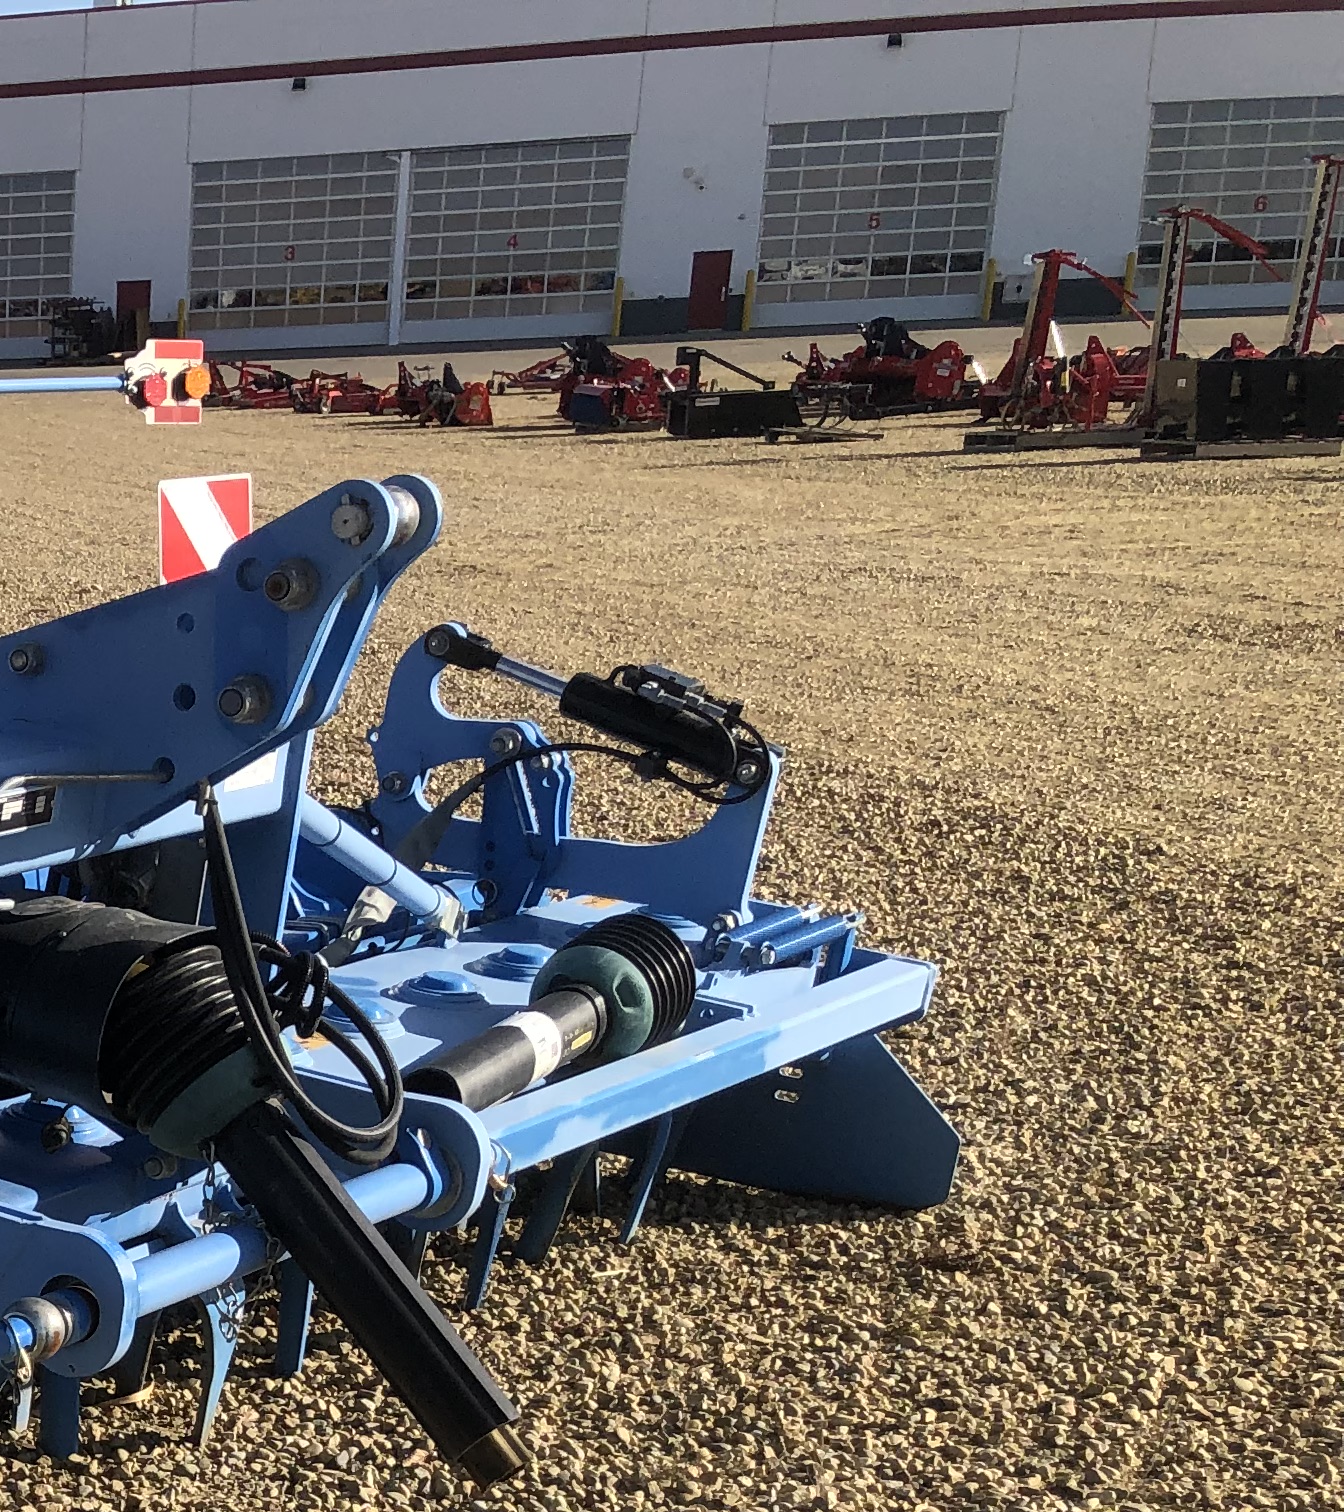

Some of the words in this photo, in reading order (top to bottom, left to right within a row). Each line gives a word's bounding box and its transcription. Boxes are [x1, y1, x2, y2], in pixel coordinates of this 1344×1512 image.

[1254, 195, 1268, 212] 6
[868, 212, 881, 229] 5
[506, 233, 518, 248] 4
[284, 245, 295, 260] 3
